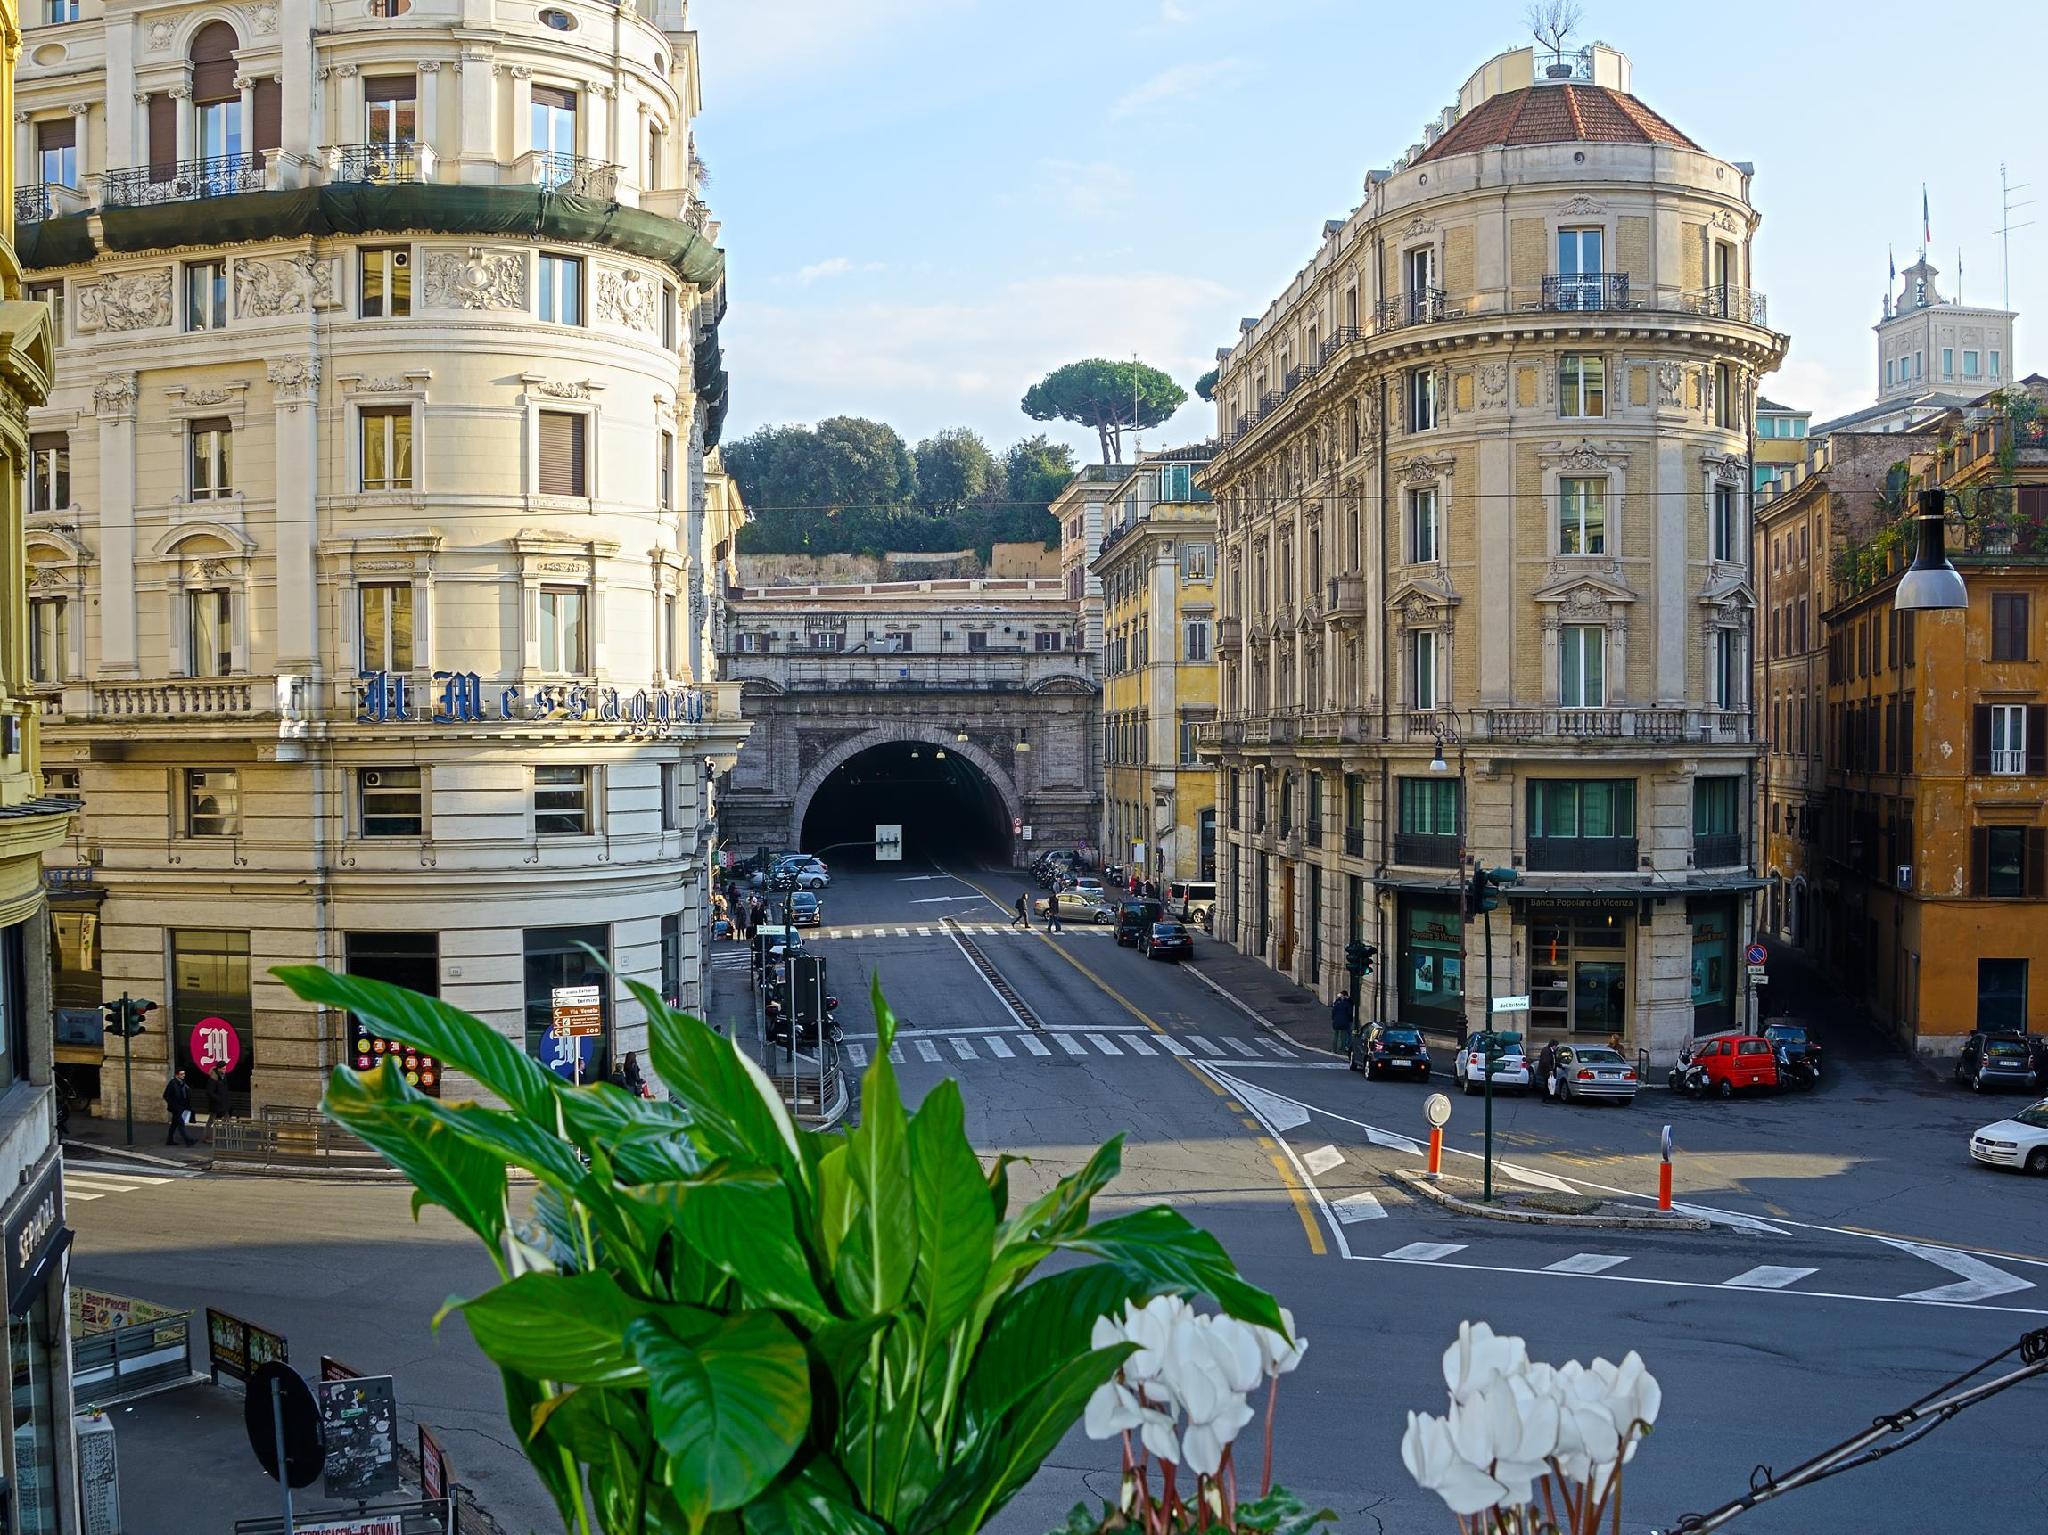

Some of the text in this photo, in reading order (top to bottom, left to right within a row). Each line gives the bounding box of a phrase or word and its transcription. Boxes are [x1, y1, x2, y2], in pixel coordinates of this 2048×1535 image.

[1530, 898, 1633, 908] Banca Popolare di Vicenza
[19, 1191, 55, 1269] SEPHORA
